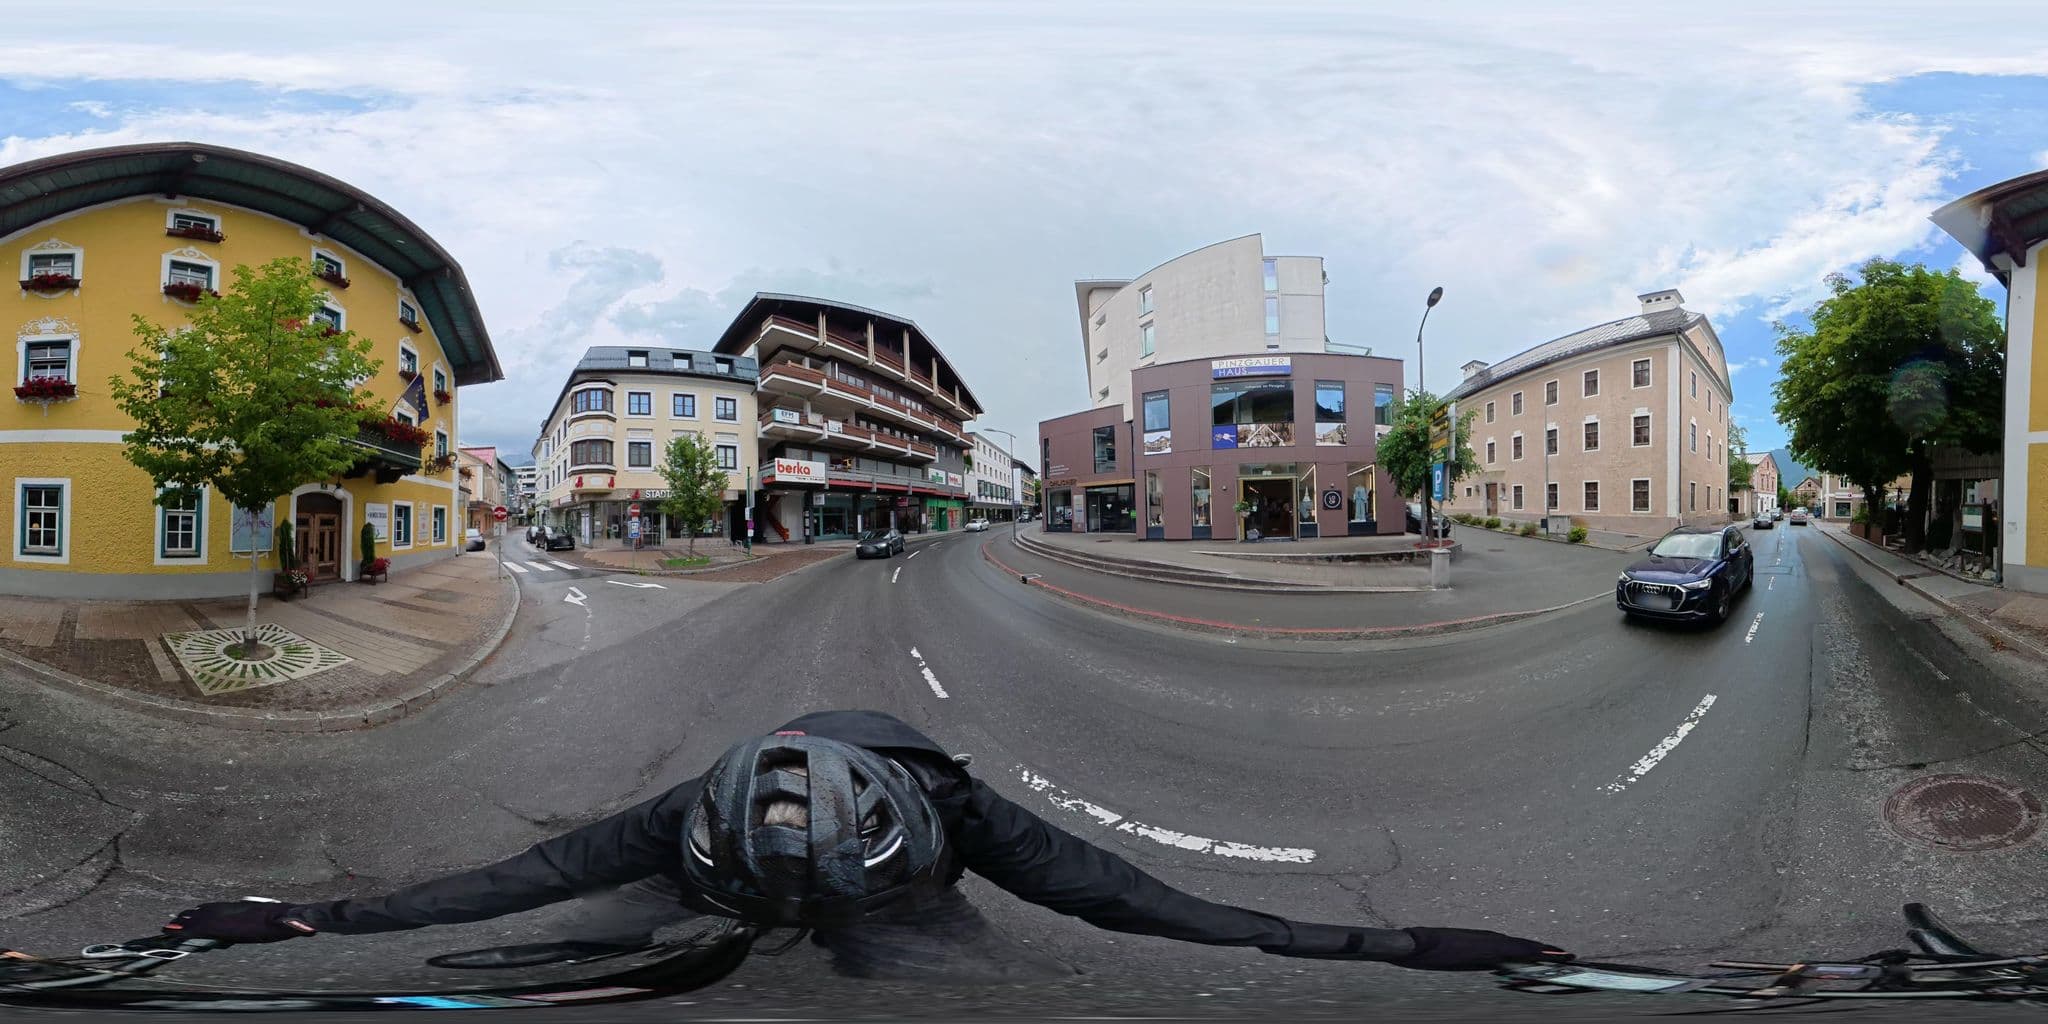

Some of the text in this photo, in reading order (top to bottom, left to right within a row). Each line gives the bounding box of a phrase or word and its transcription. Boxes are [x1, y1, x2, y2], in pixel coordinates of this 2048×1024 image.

[1218, 358, 1285, 368] PINZGAUER
[1218, 367, 1248, 377] HAUS
[777, 459, 811, 475] berka
